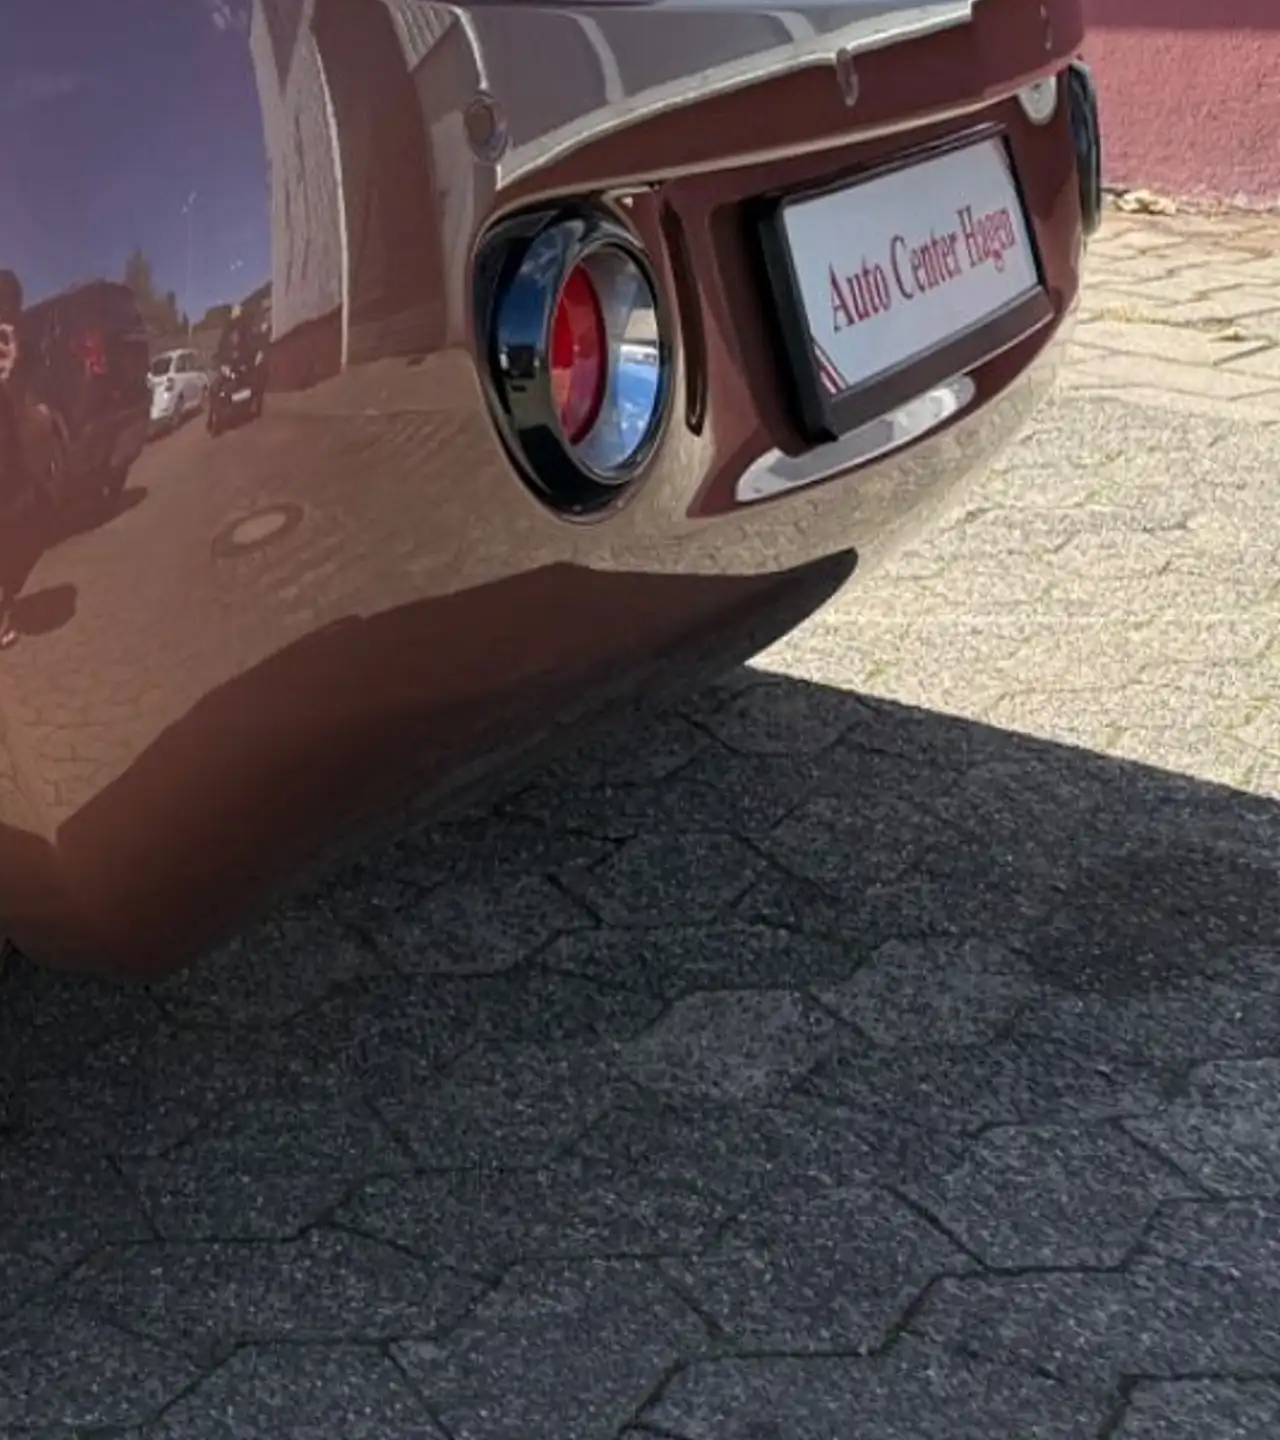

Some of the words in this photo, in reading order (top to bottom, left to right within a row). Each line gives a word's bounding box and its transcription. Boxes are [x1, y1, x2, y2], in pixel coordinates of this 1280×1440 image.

[828, 258, 891, 334] Auto
[890, 233, 963, 300] Center
[956, 204, 1017, 274] Hagen
